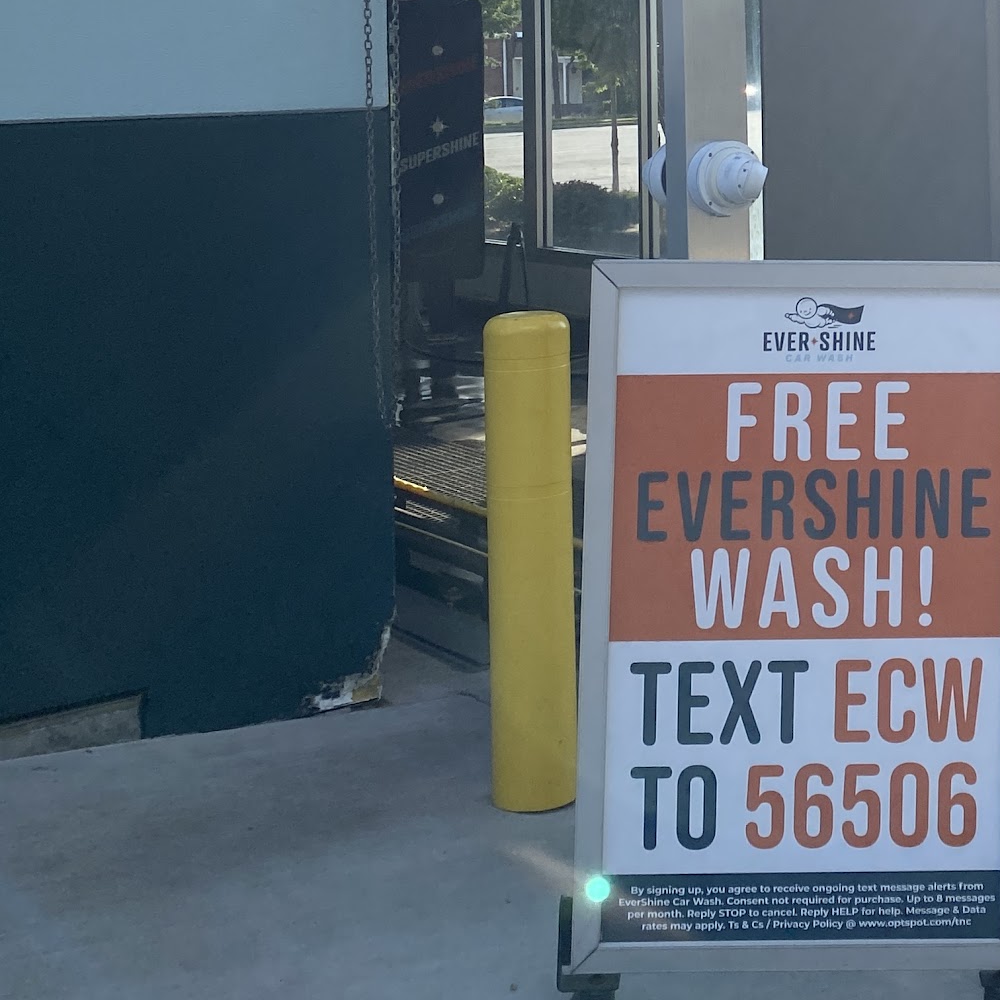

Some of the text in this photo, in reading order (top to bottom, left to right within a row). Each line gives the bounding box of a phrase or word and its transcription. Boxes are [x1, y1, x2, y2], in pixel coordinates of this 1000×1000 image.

[399, 131, 479, 172] SUPERSHINE
[785, 354, 853, 362] CAR WASH
[726, 381, 910, 462] FREE
[636, 468, 991, 542] EVERSHINE
[691, 546, 934, 630] WASH!
[630, 657, 983, 746] TEXT ECW
[630, 762, 977, 851] TO 56506
[619, 893, 996, 906] EverShine Car Wash. Consent not required for purchase. Up to 8 messages
[631, 881, 984, 896] By signing up, you agree to receive ongoing text message alerts from
[628, 904, 987, 920] per month. Reply STOP to cancel. Reply HELP for help. Message & Data
[642, 921, 668, 930] rates
[671, 922, 693, 931] may
[695, 920, 727, 931] apply.
[729, 920, 740, 929] Ts
[742, 920, 750, 928] &
[752, 919, 764, 928] Cs
[773, 919, 811, 930] Privacy
[813, 918, 844, 929] Policy
[846, 918, 857, 929] @
[859, 917, 972, 929] www.optspot.com/tnc
